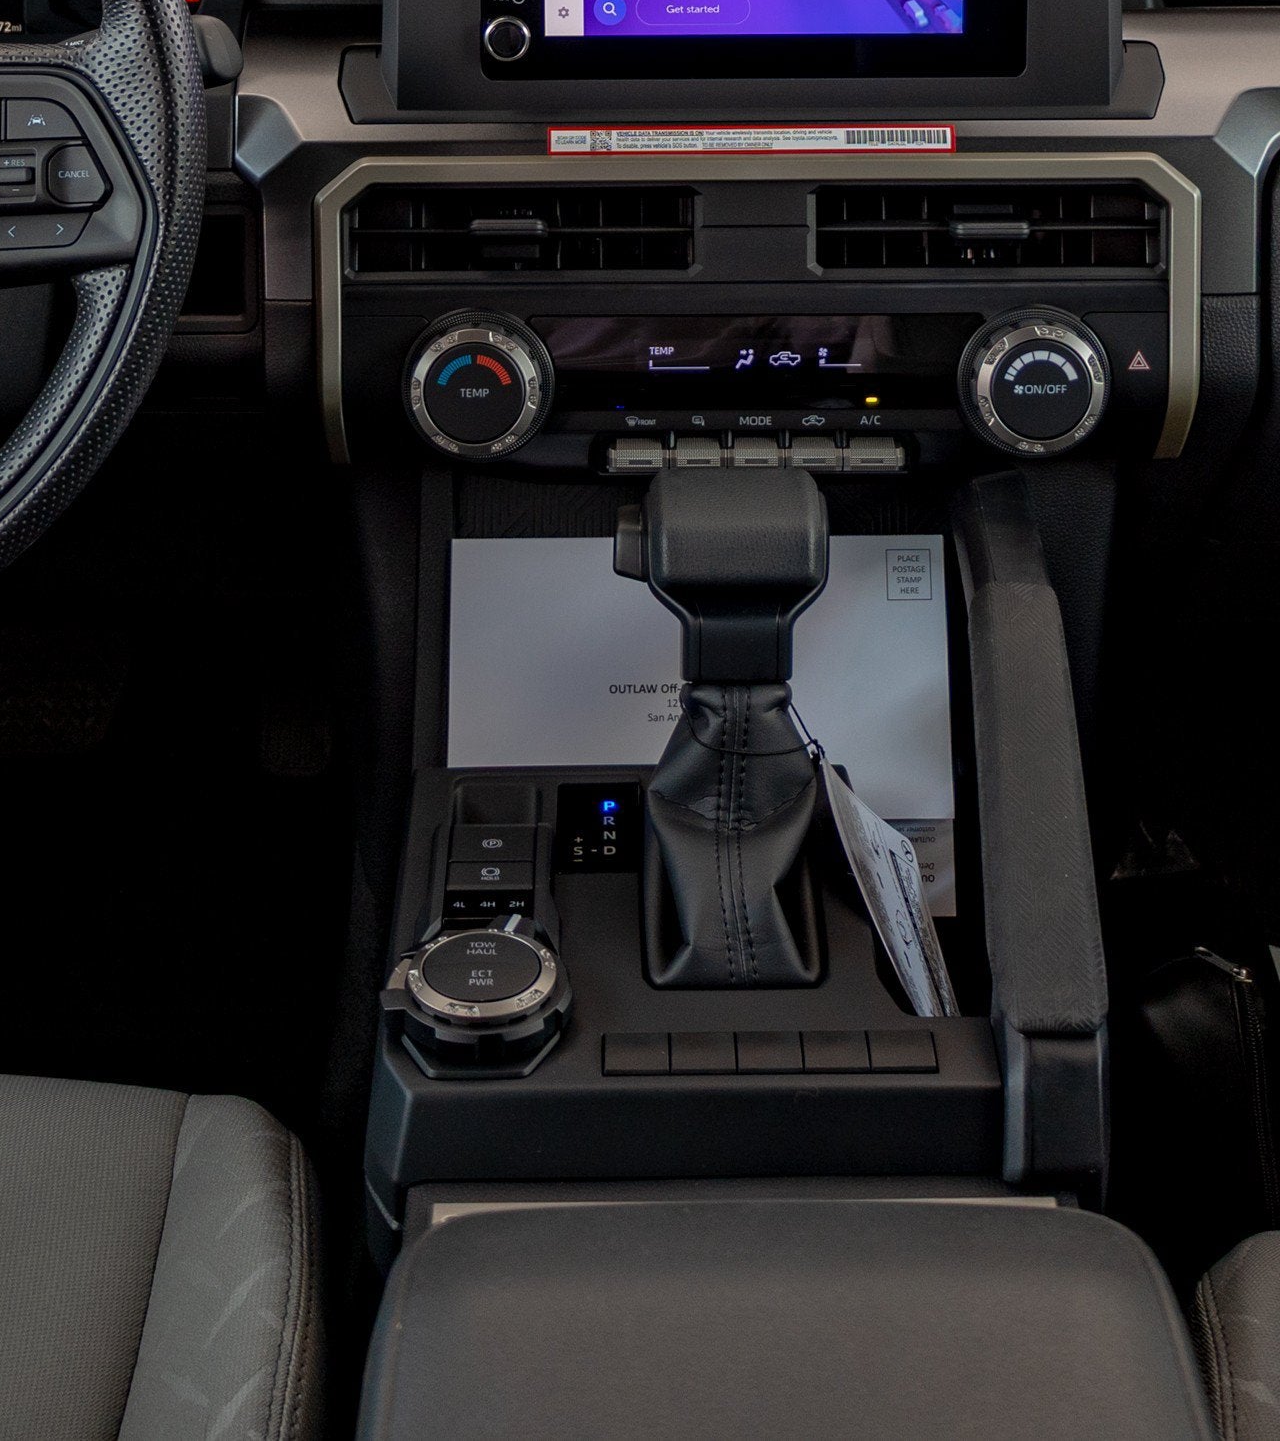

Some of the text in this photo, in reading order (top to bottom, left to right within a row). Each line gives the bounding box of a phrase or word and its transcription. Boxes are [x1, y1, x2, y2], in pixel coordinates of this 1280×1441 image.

[666, 4, 721, 14] Get started
[57, 170, 90, 178] CANCEL
[648, 346, 674, 355] TEMP
[459, 387, 489, 398] TEMP
[1023, 383, 1067, 394] ON/OFF
[636, 417, 658, 425] FRONT
[738, 415, 773, 426] MODE
[859, 415, 881, 426] A/C
[897, 555, 920, 563] PLACE
[892, 565, 926, 574] POSTAGE
[896, 576, 922, 585] STAMP
[900, 586, 920, 595] HERE
[609, 684, 658, 694] OUTLAW
[647, 712, 665, 722] San
[602, 800, 616, 812] P
[602, 816, 616, 826] R
[602, 830, 617, 841] N
[572, 846, 617, 856] S D
[508, 900, 525, 908] 2H
[466, 948, 498, 956] HAUL
[471, 969, 493, 978] ECT
[468, 978, 494, 987] PWR
